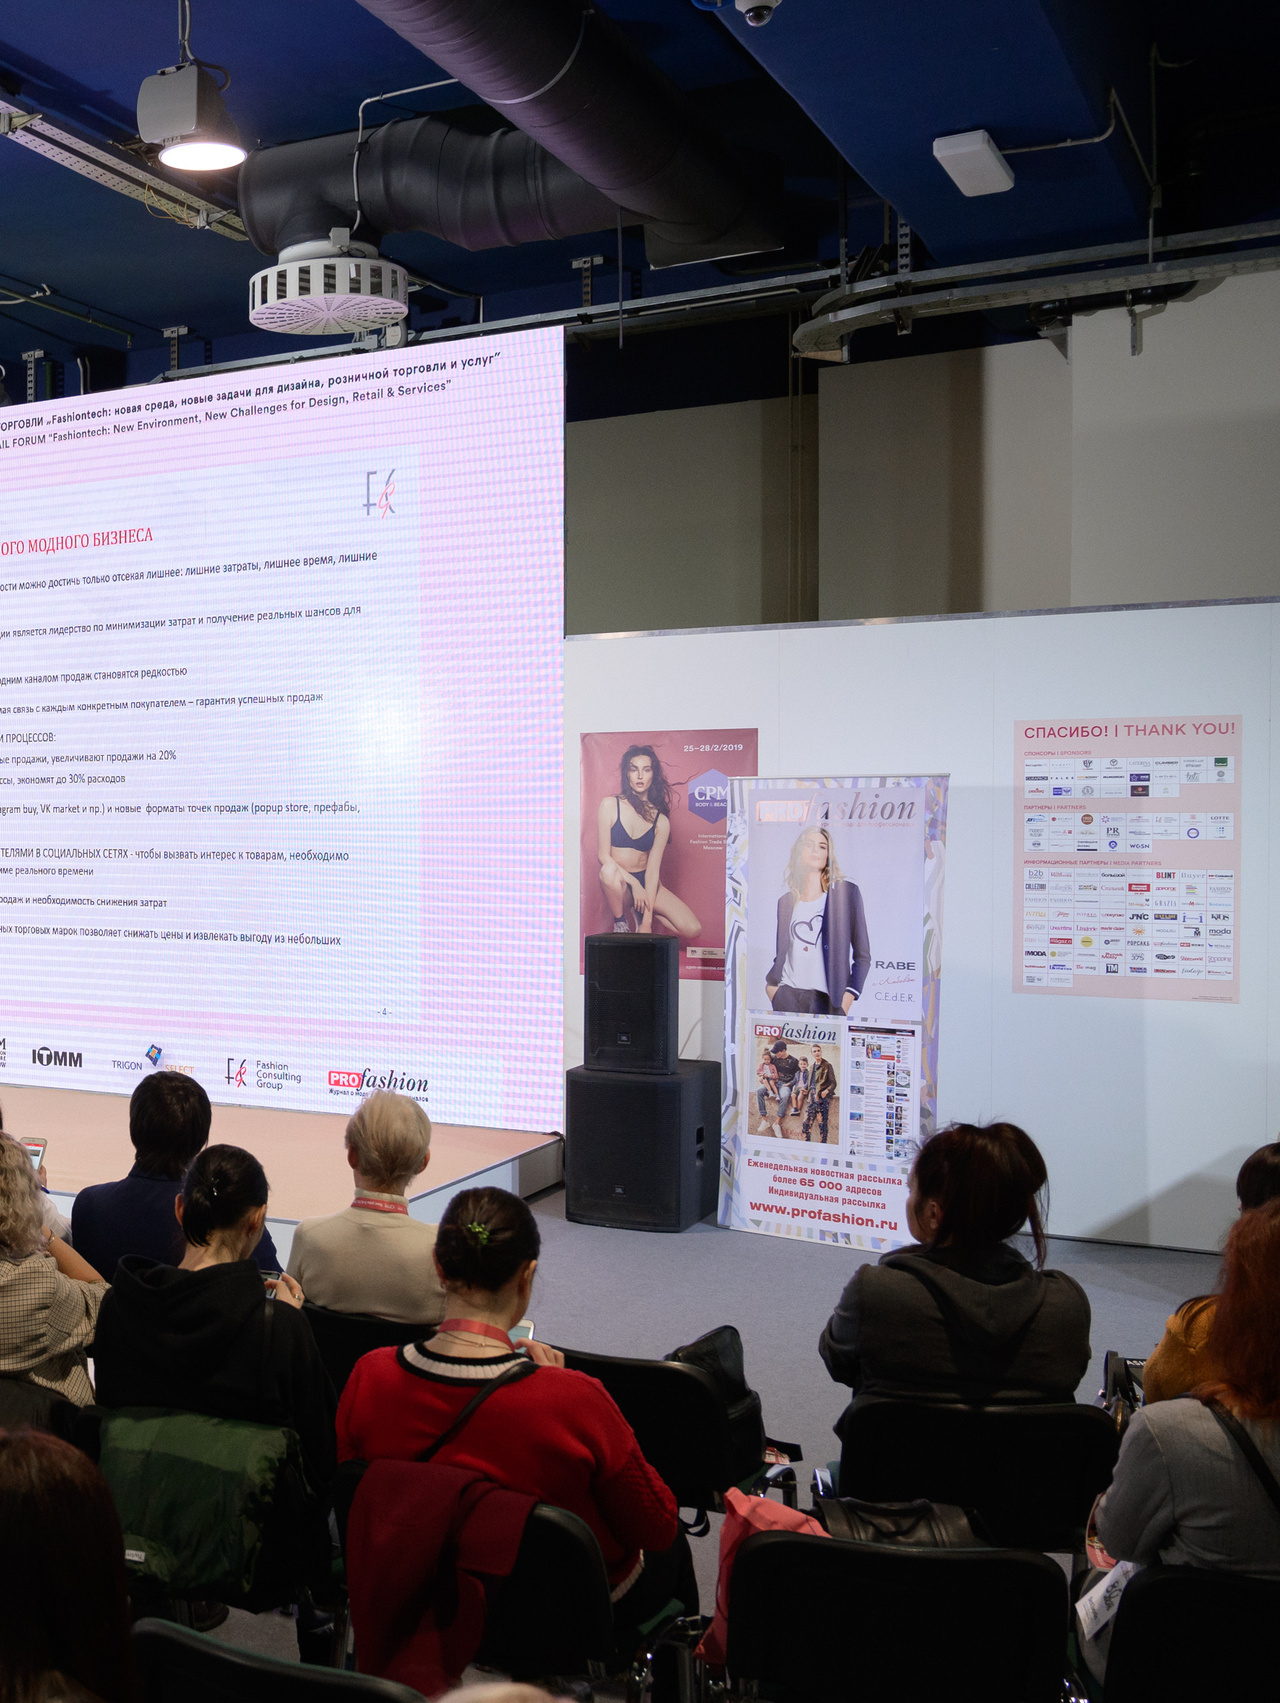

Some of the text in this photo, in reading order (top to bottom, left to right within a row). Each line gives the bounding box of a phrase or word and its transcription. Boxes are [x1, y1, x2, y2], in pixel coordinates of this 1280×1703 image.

[113, 404, 142, 414] новая
[143, 399, 177, 412] среда,
[180, 394, 213, 405] новые
[216, 388, 252, 401] задачи
[254, 385, 273, 396] для
[276, 379, 324, 393] дизайна,
[327, 367, 389, 387] розничной
[392, 362, 446, 376] торговли
[450, 360, 457, 368] и
[12, 434, 46, 446] FORUM
[112, 424, 134, 433] New
[136, 414, 201, 430] Environment,
[204, 411, 227, 420] New
[229, 403, 287, 417] Challenges
[289, 399, 305, 409] for
[308, 395, 349, 407] Design,
[352, 388, 383, 401] Retail
[386, 387, 395, 396] &
[27, 533, 89, 553] МОДНОГО
[92, 527, 153, 546] БИЗНЕСА
[18, 580, 47, 589] можно
[47, 578, 80, 588] достичь
[81, 574, 110, 584] только
[111, 571, 144, 582] отсекая
[145, 568, 183, 578] лишнее:
[184, 565, 221, 575] лишние
[222, 562, 261, 572] затраты,
[263, 558, 301, 568] лишнее
[302, 555, 336, 565] время,
[337, 552, 378, 562] лишние
[1024, 726, 1108, 739] СПАСИБО!
[1124, 722, 1236, 737] THANK YOU!
[694, 786, 728, 800] CPM
[42, 848, 101, 859] СОЦИАЛЬНЫХ
[102, 848, 128, 858] СЕТЯХ
[134, 847, 161, 859] чтобы
[162, 850, 198, 859] вызвать
[199, 851, 236, 859] интерес
[244, 851, 287, 860] товарам,
[289, 848, 349, 861] необходимо
[876, 960, 916, 970] RABE
[756, 1022, 837, 1041] PROfashion
[112, 1060, 142, 1071] TRIGON
[256, 1061, 289, 1071] Fashion
[256, 1070, 301, 1084] Consulting
[256, 1080, 283, 1091] Group
[330, 1068, 428, 1092] PROfashion
[748, 1158, 902, 1186] Еженедельная новостная рассылка
[772, 1174, 882, 1196] более 65 000 адресов
[768, 1186, 886, 1210] Индивидуальная рассылка
[749, 1201, 898, 1231] www.profashion.ru
